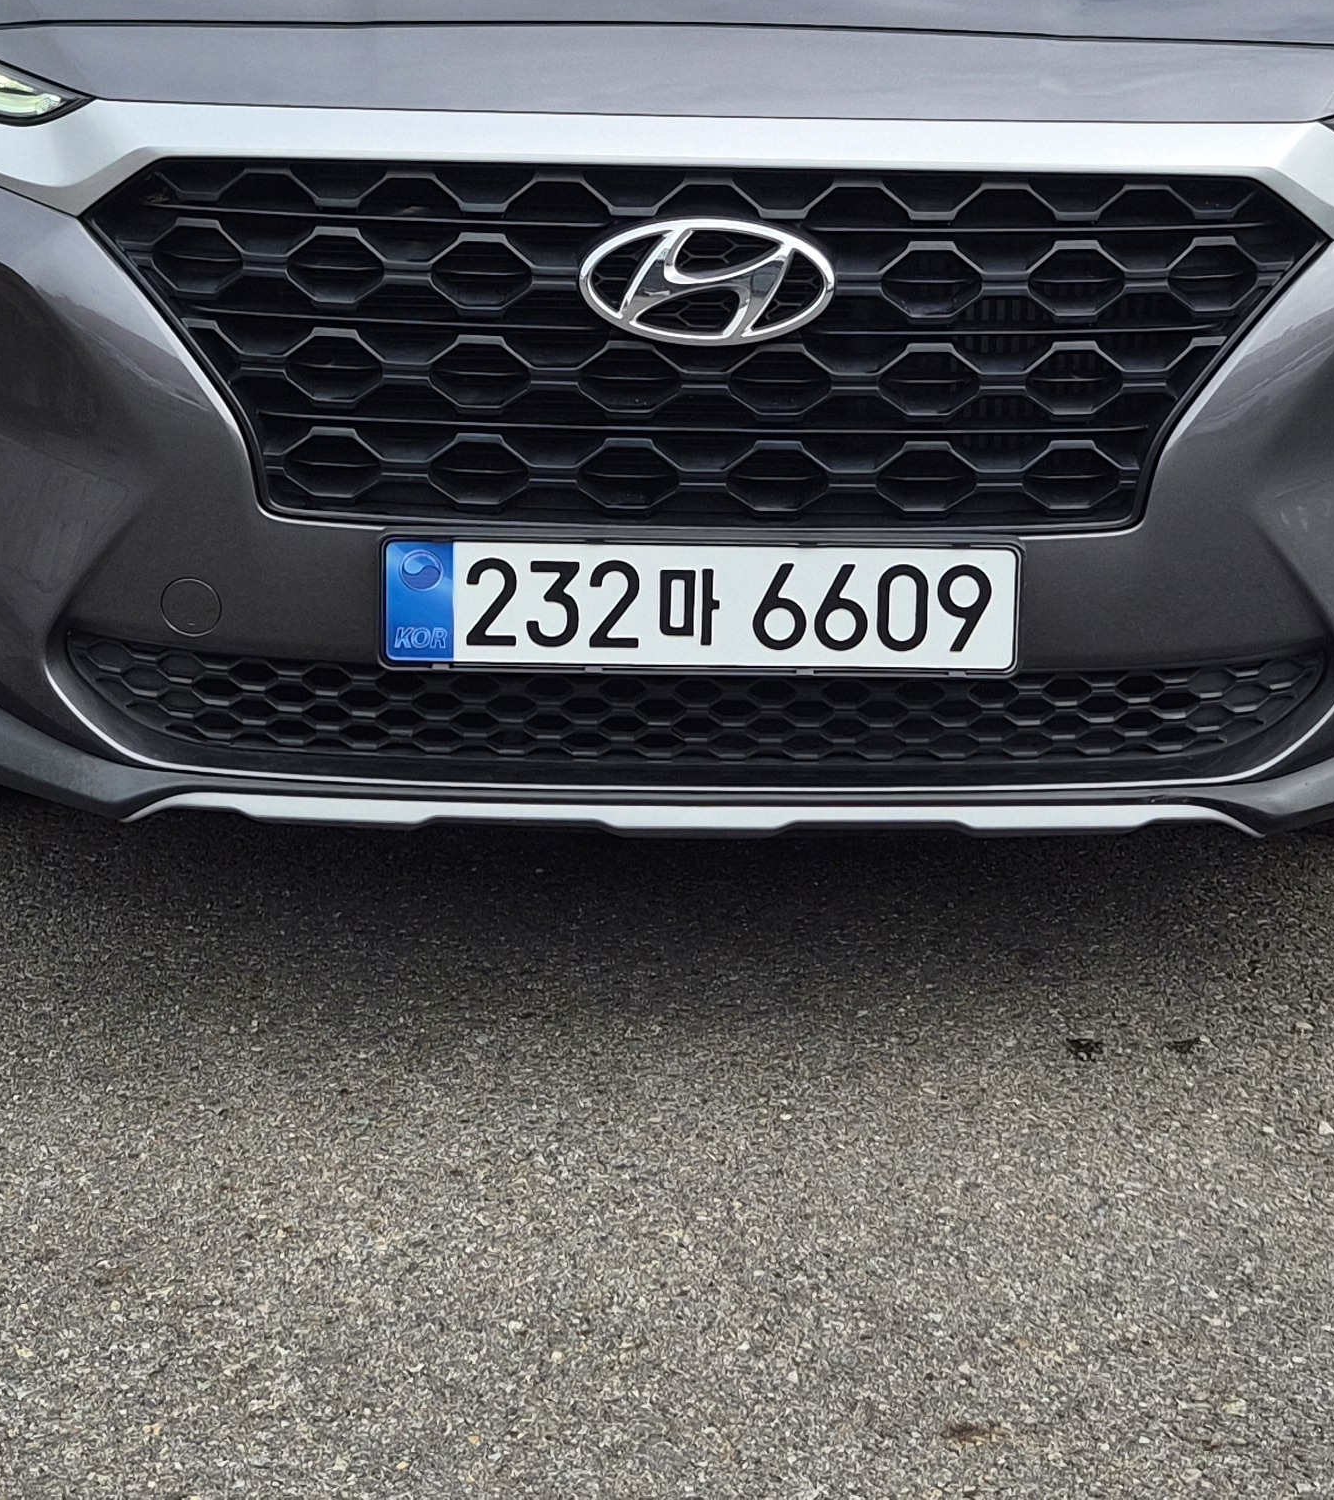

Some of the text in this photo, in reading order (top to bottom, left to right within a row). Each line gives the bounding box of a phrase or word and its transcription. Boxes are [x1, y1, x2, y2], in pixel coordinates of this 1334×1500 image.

[466, 557, 993, 652] 232마 6609
[394, 626, 448, 649] KOR
